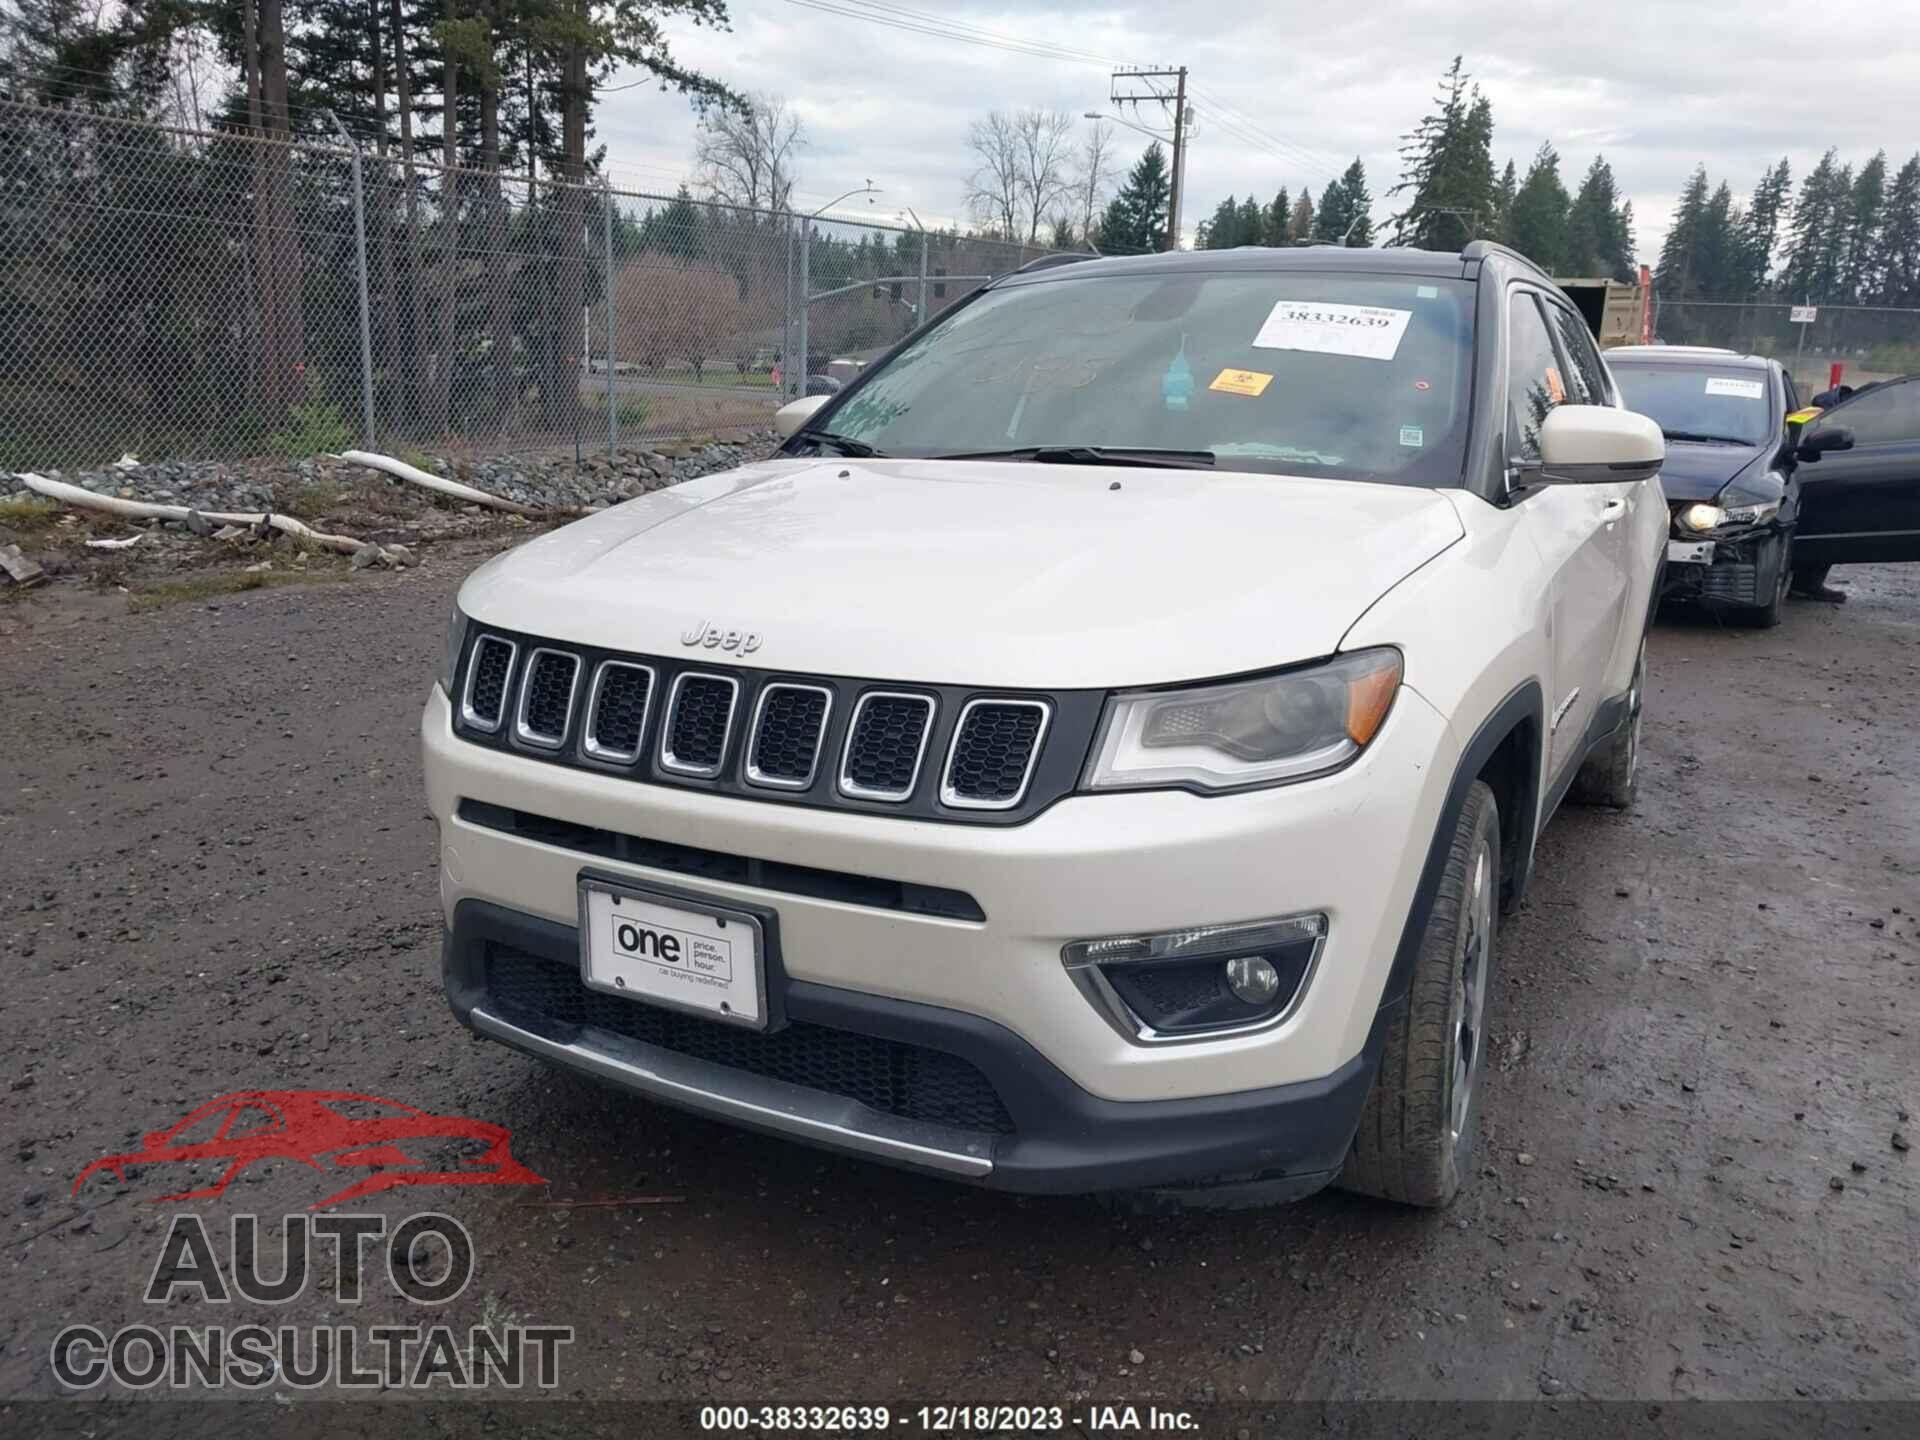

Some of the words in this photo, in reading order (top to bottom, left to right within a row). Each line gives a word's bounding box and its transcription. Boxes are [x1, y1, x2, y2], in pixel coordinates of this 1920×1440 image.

[1281, 311, 1390, 328] 38332639
[681, 617, 767, 658] Jeep
[618, 924, 681, 962] one
